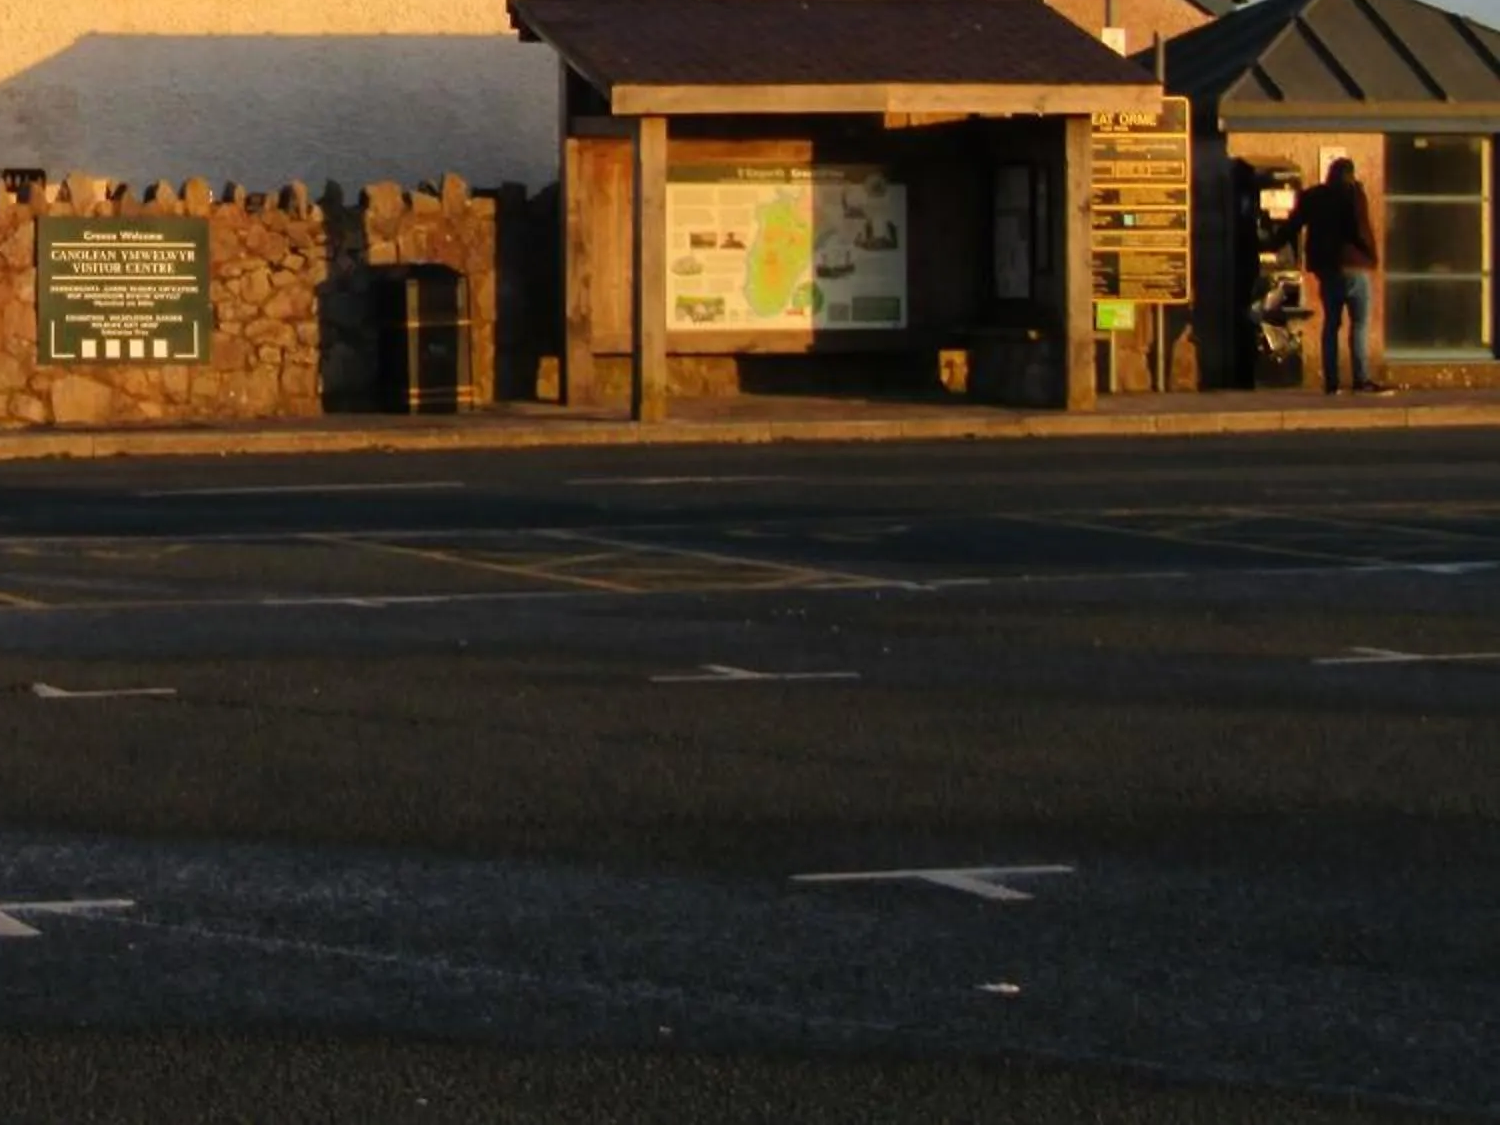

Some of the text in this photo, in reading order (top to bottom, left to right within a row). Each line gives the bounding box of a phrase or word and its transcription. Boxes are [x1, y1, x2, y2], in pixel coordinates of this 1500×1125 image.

[51, 250, 117, 262] CANOLFAN
[72, 262, 176, 274] VISITOR CENTRE
